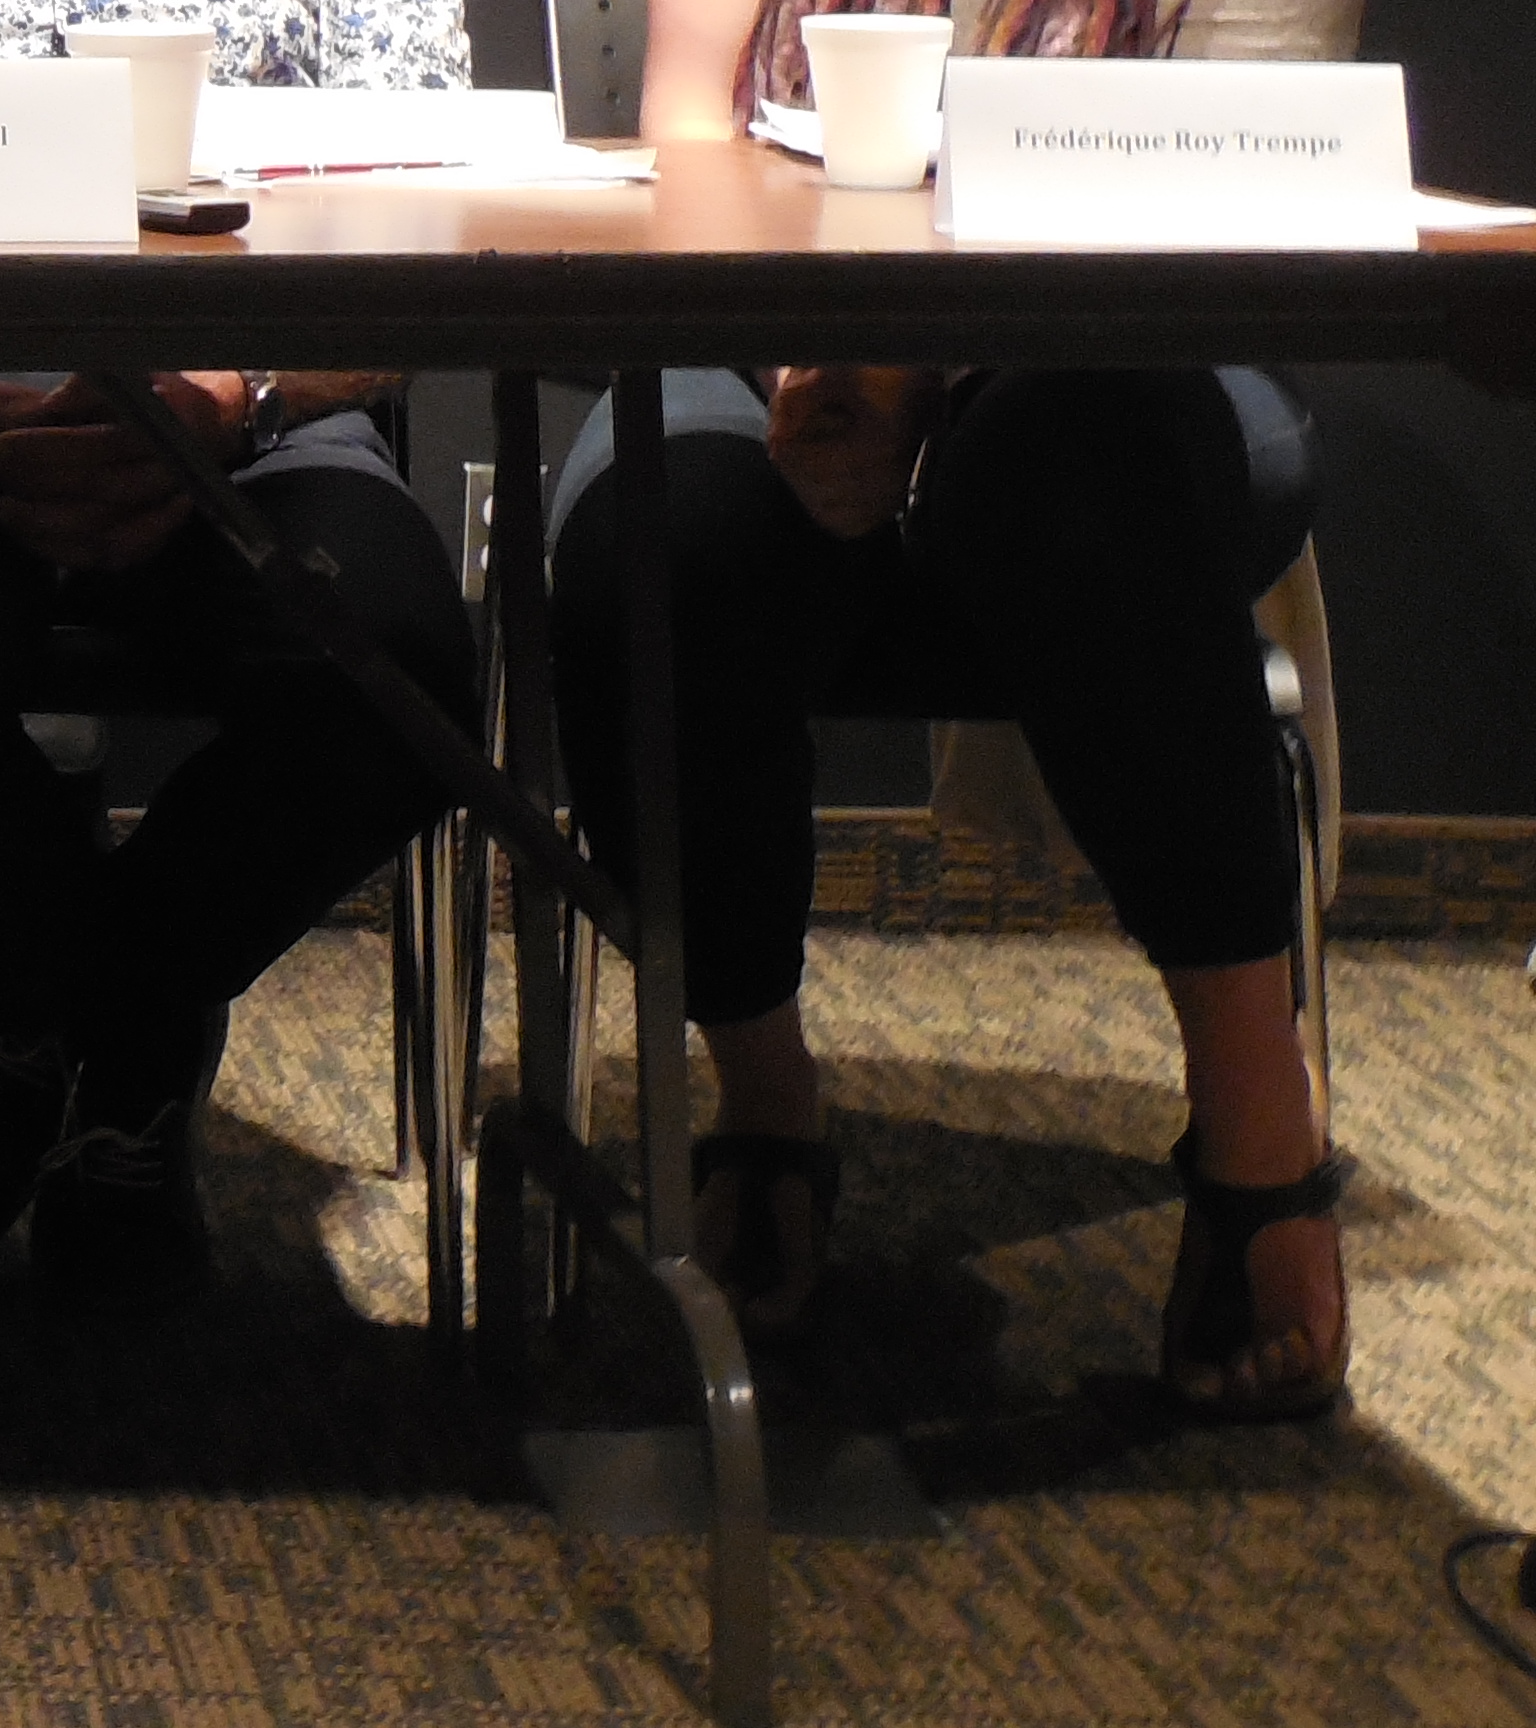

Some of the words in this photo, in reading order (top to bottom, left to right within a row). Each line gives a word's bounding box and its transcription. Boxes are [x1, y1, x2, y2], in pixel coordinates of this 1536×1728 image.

[1014, 126, 1166, 156] Frédérique
[1174, 130, 1225, 156] Roy
[1232, 131, 1342, 158] Trempe
